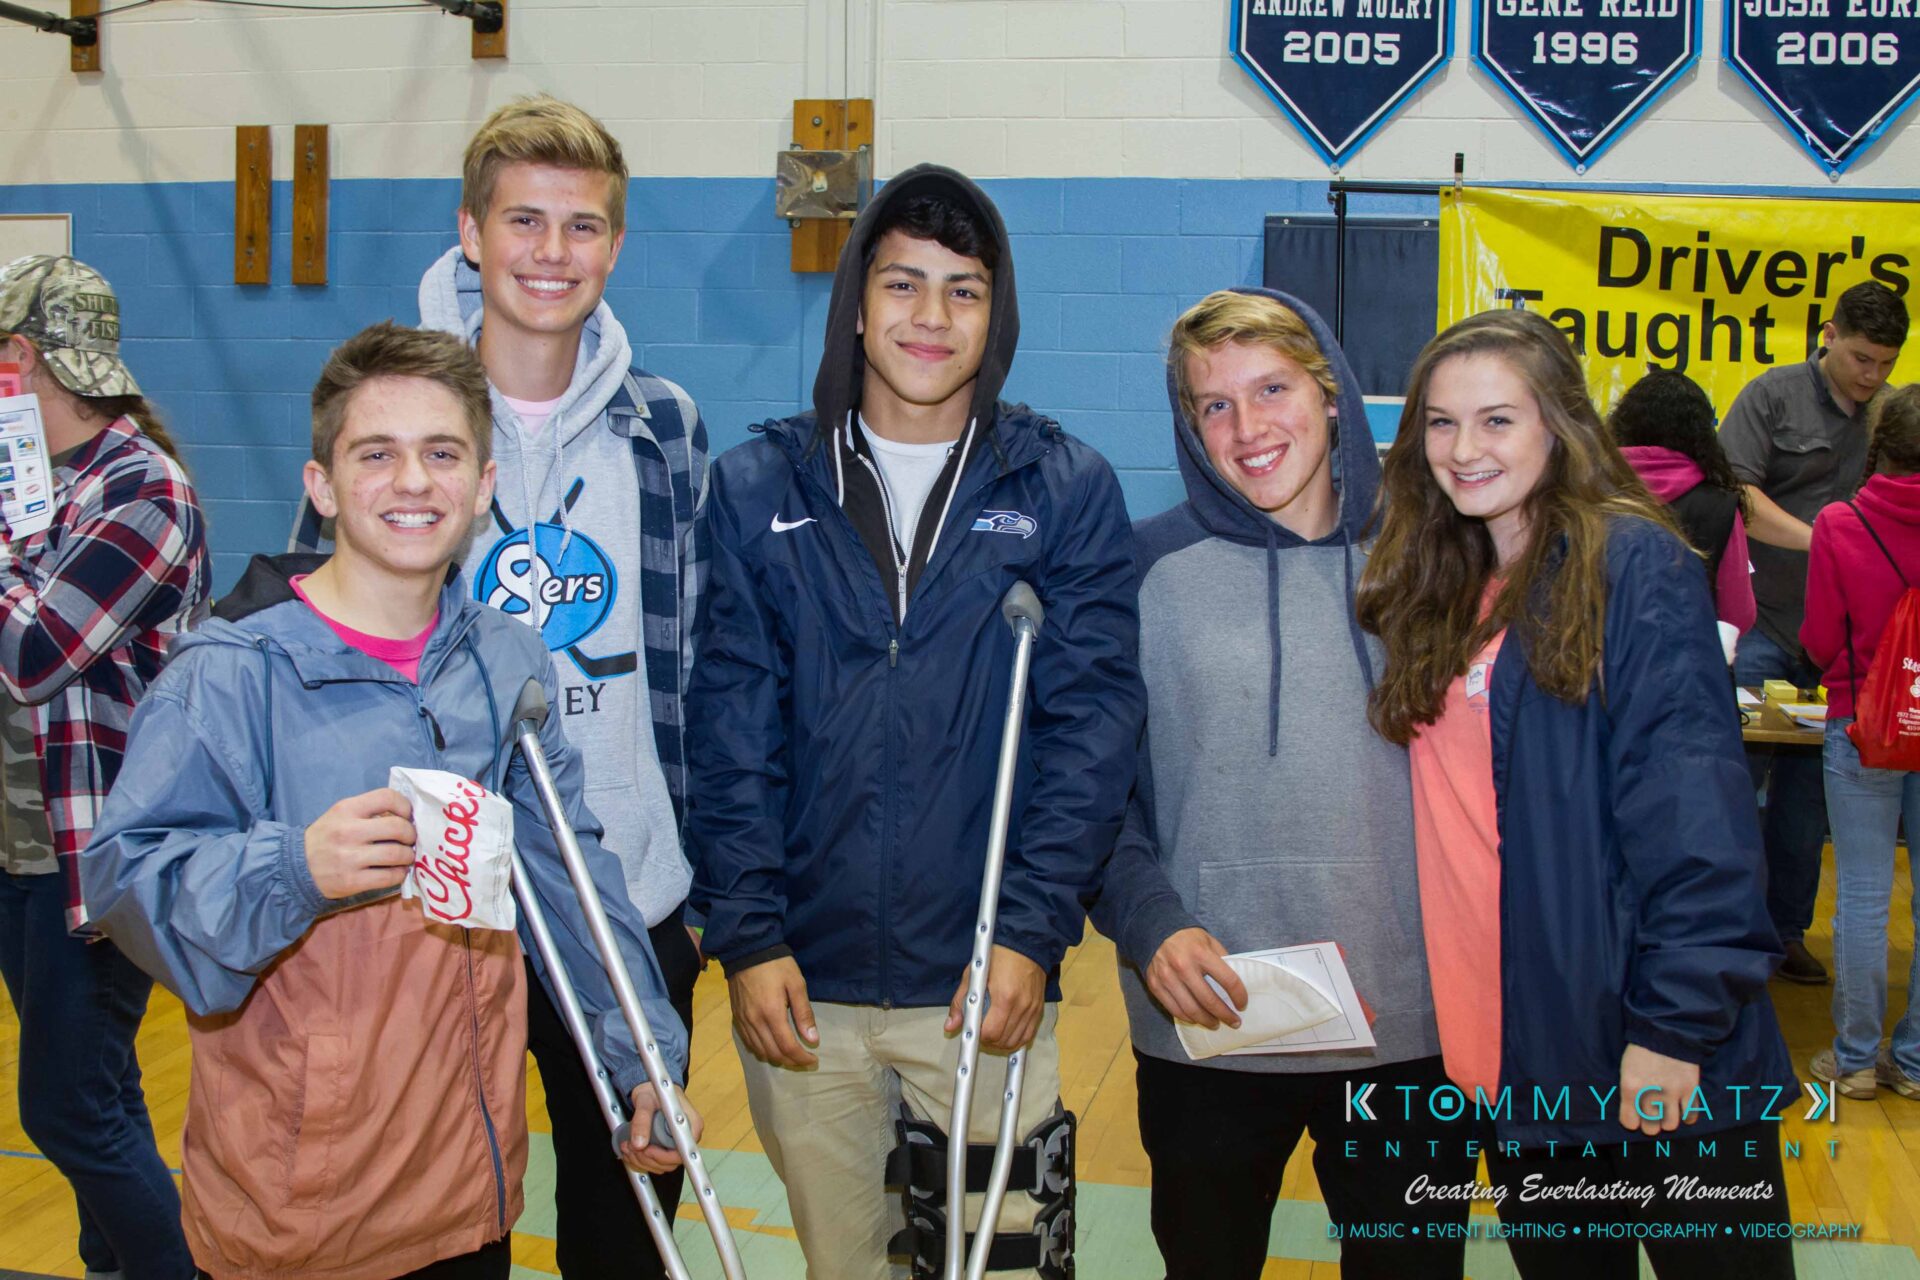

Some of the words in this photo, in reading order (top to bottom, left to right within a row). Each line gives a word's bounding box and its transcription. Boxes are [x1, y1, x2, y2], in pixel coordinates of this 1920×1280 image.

[1846, 0, 1920, 17] EUR
[1283, 31, 1400, 65] 2005
[1532, 31, 1638, 65] 1996
[1777, 32, 1898, 65] 2006
[1598, 226, 1910, 298] Driver's
[487, 541, 604, 630] 8ers
